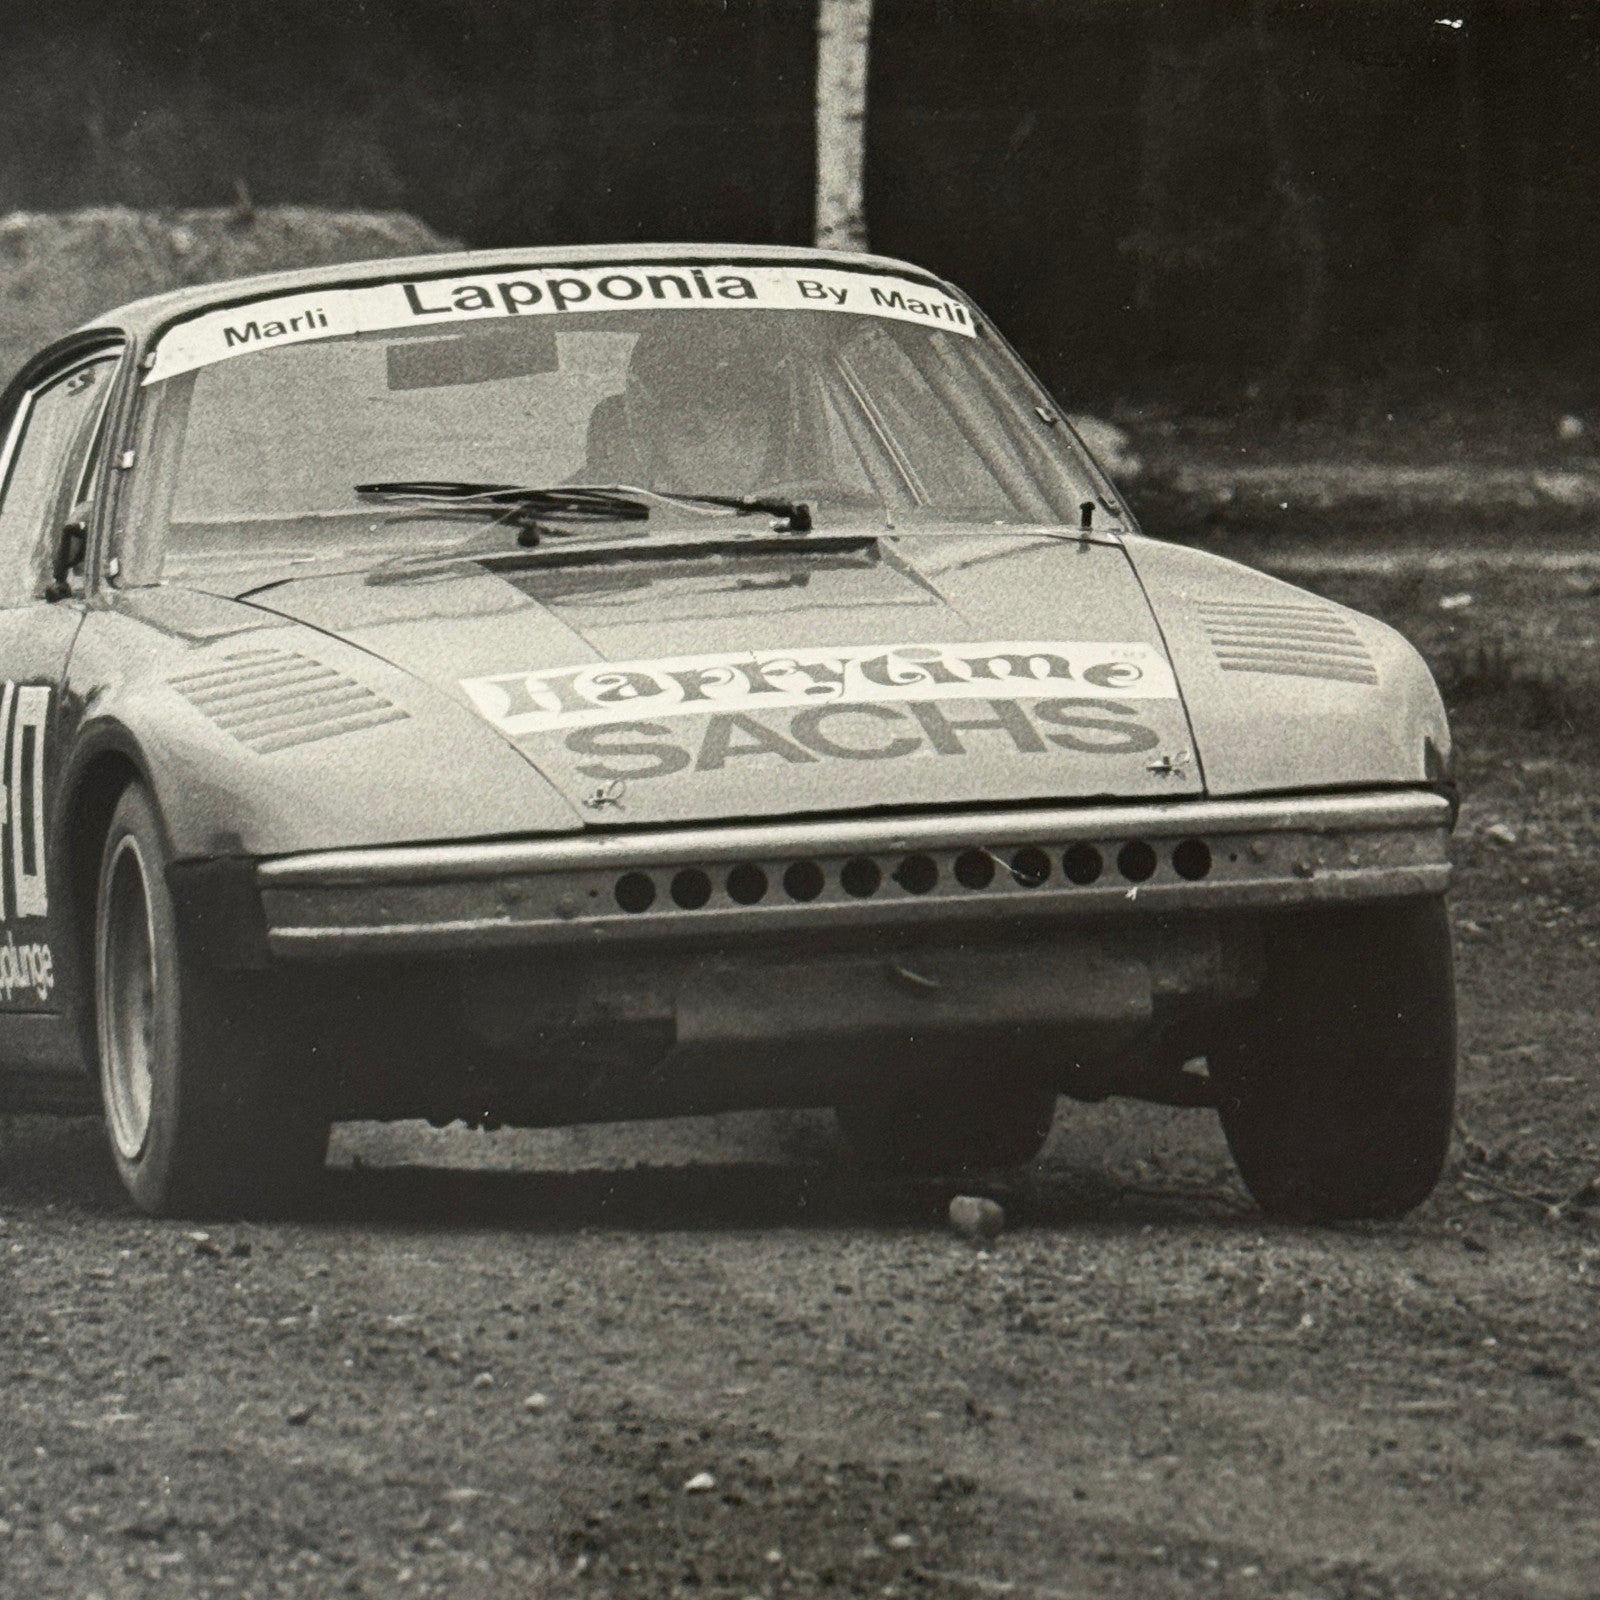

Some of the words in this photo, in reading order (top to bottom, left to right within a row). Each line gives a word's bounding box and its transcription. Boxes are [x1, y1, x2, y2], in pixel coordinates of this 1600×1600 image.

[223, 307, 329, 348] Marli
[404, 267, 757, 317] Lapponia
[798, 279, 848, 312] By
[871, 286, 967, 327] Marli
[565, 697, 1161, 782] SACHS
